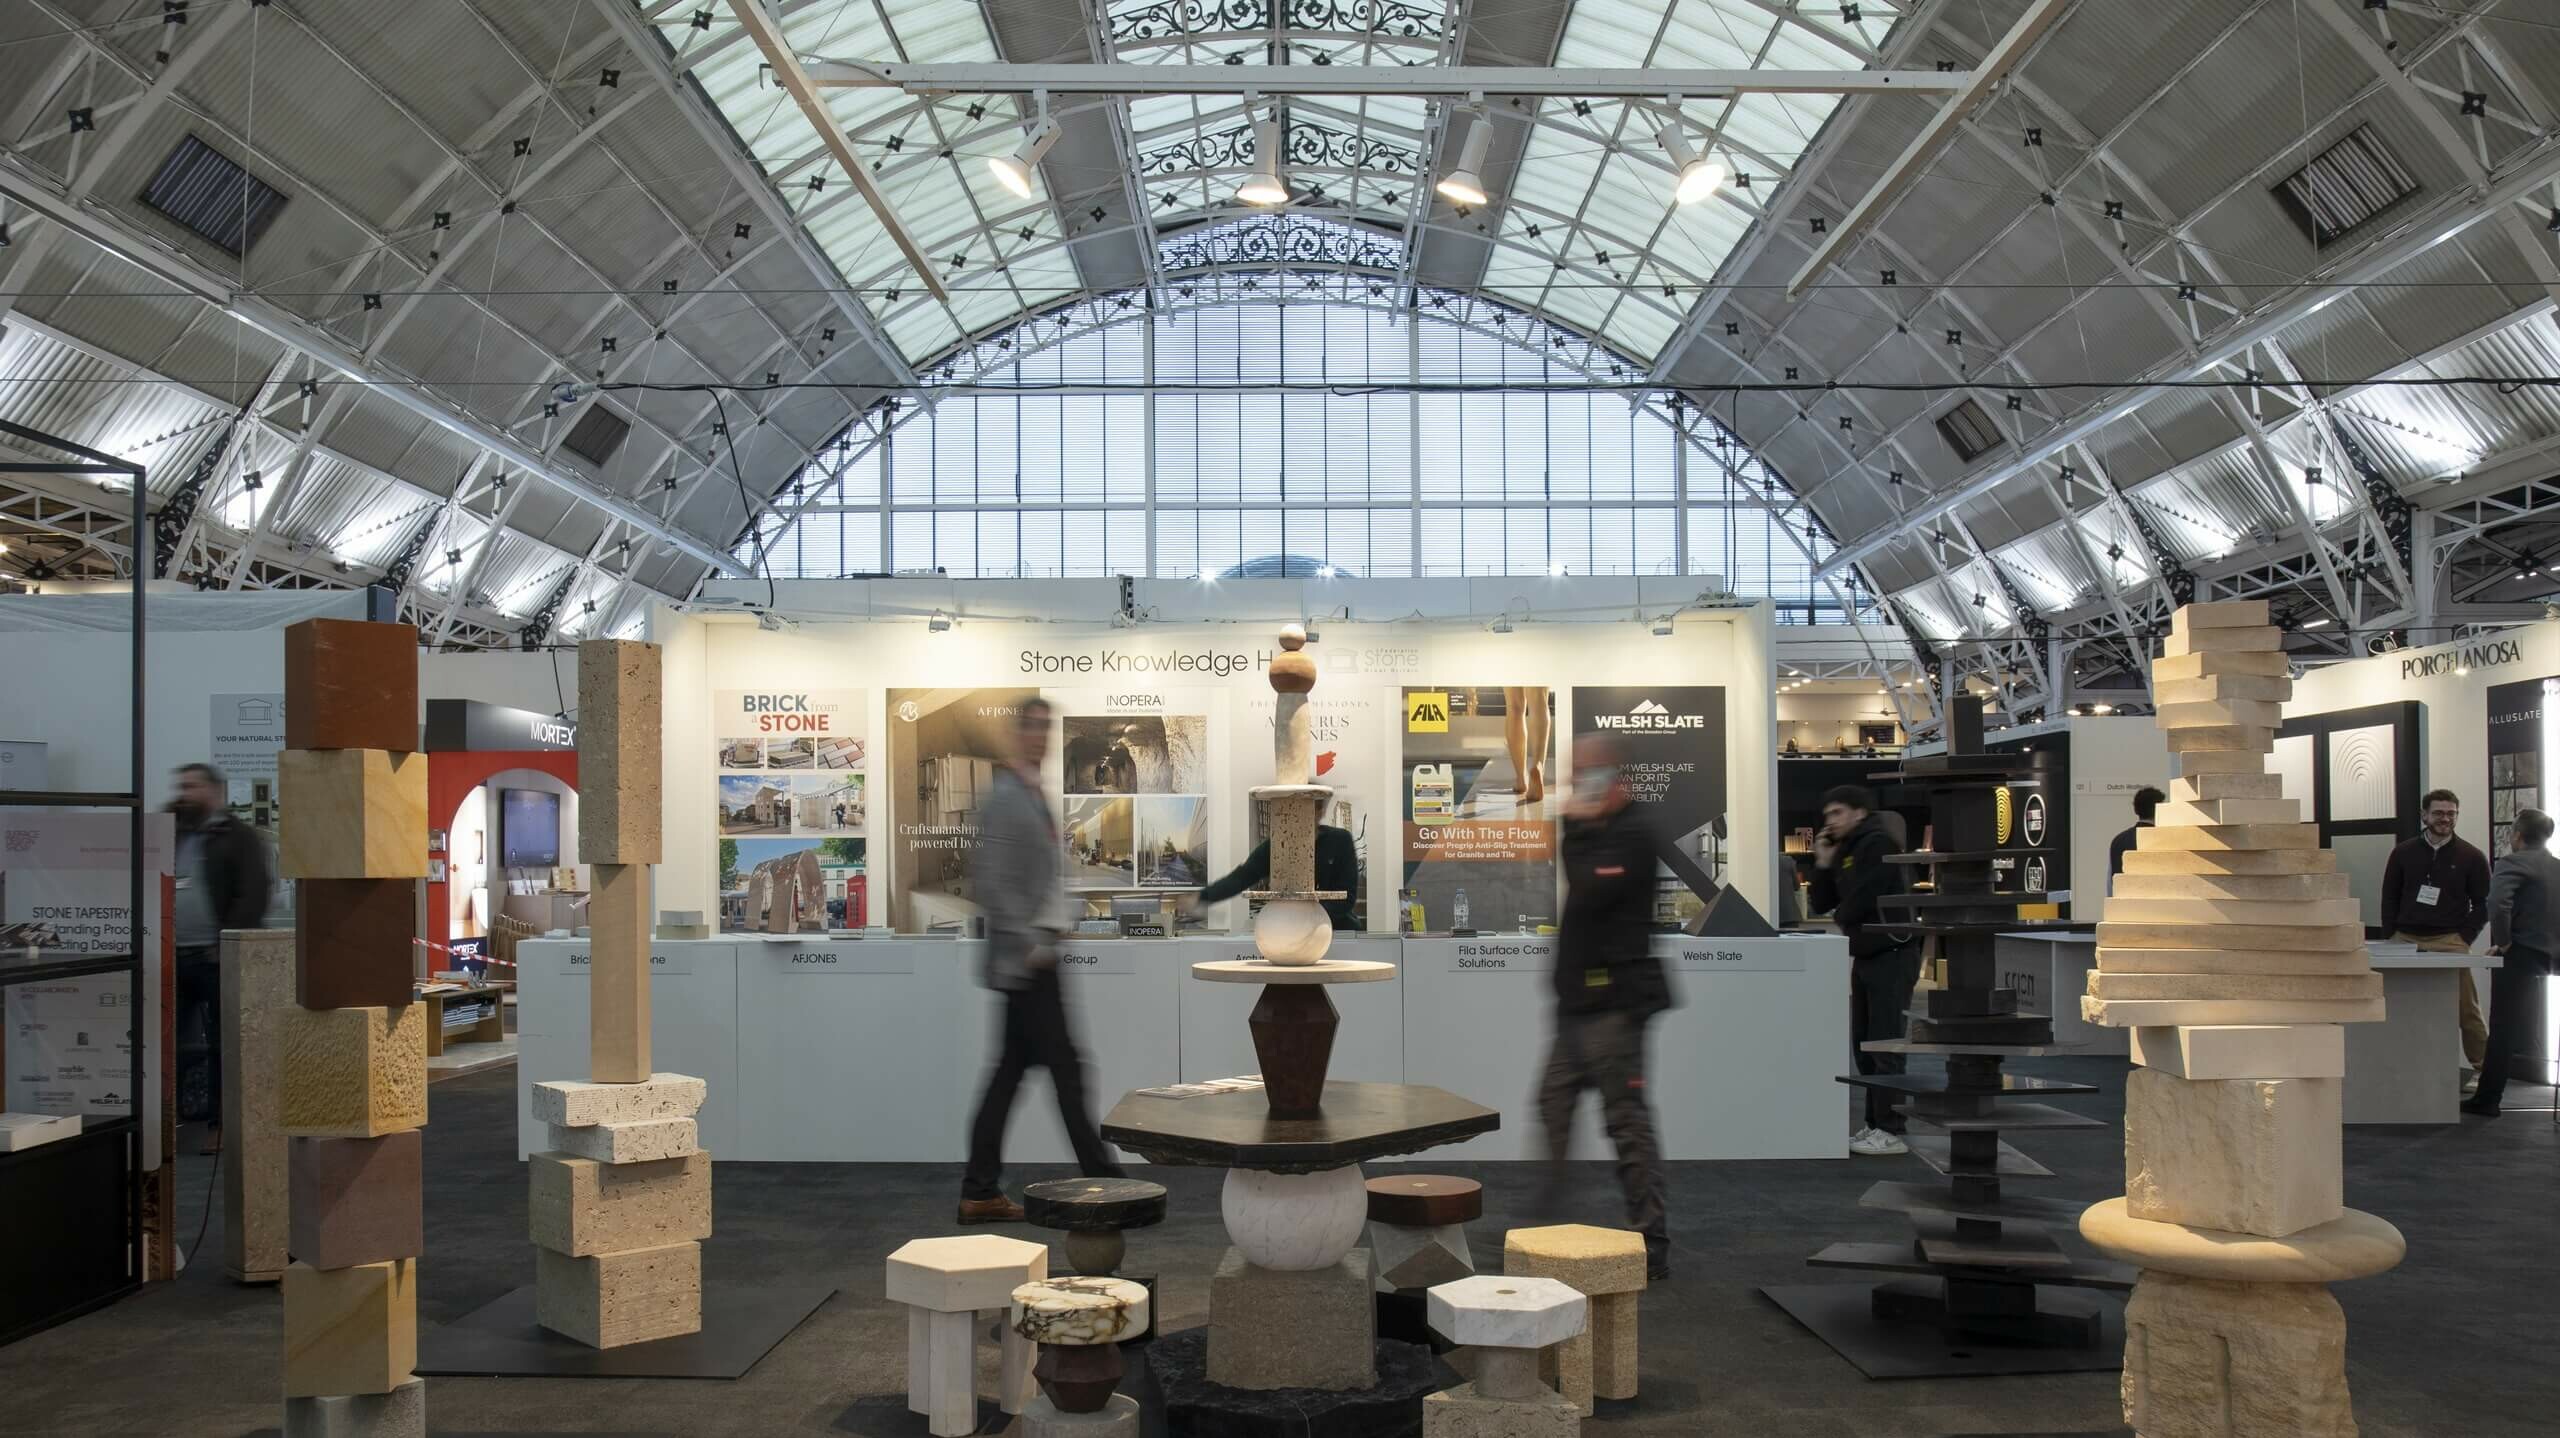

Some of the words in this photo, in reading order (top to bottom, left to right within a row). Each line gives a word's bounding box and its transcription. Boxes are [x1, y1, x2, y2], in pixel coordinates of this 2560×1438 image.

[1020, 650, 1093, 672] Stone
[1102, 650, 1248, 677] Knowledge
[1364, 650, 1419, 666] Stone
[743, 695, 809, 712] BRICK
[811, 702, 838, 712] from
[1411, 704, 1446, 721] FILA
[760, 714, 829, 732] STONE
[1595, 715, 1652, 728] WELSH
[1654, 715, 1704, 728] SLATE
[530, 722, 575, 746] MORTEX
[1631, 763, 1664, 772] WELSH
[1666, 763, 1695, 772] SLATE
[1635, 773, 1657, 782] FOR
[1657, 773, 1670, 782] ITS
[1632, 784, 1670, 792] BEAUTY
[900, 823, 979, 837] Craftsmanship
[1419, 827, 1439, 840] Go
[1443, 827, 1474, 840] With
[1478, 827, 1504, 840] The
[1508, 827, 1540, 840] Flow
[910, 837, 957, 852] powered
[32, 906, 72, 919] STONE
[1458, 945, 1476, 955] Fila
[1479, 945, 1520, 955] Surface
[1523, 945, 1550, 955] Care
[1683, 951, 1714, 961] Welsh
[1716, 951, 1743, 961] Slate
[792, 953, 837, 964] AFJONES
[1063, 954, 1098, 966] Group
[1458, 958, 1506, 968] Solutions
